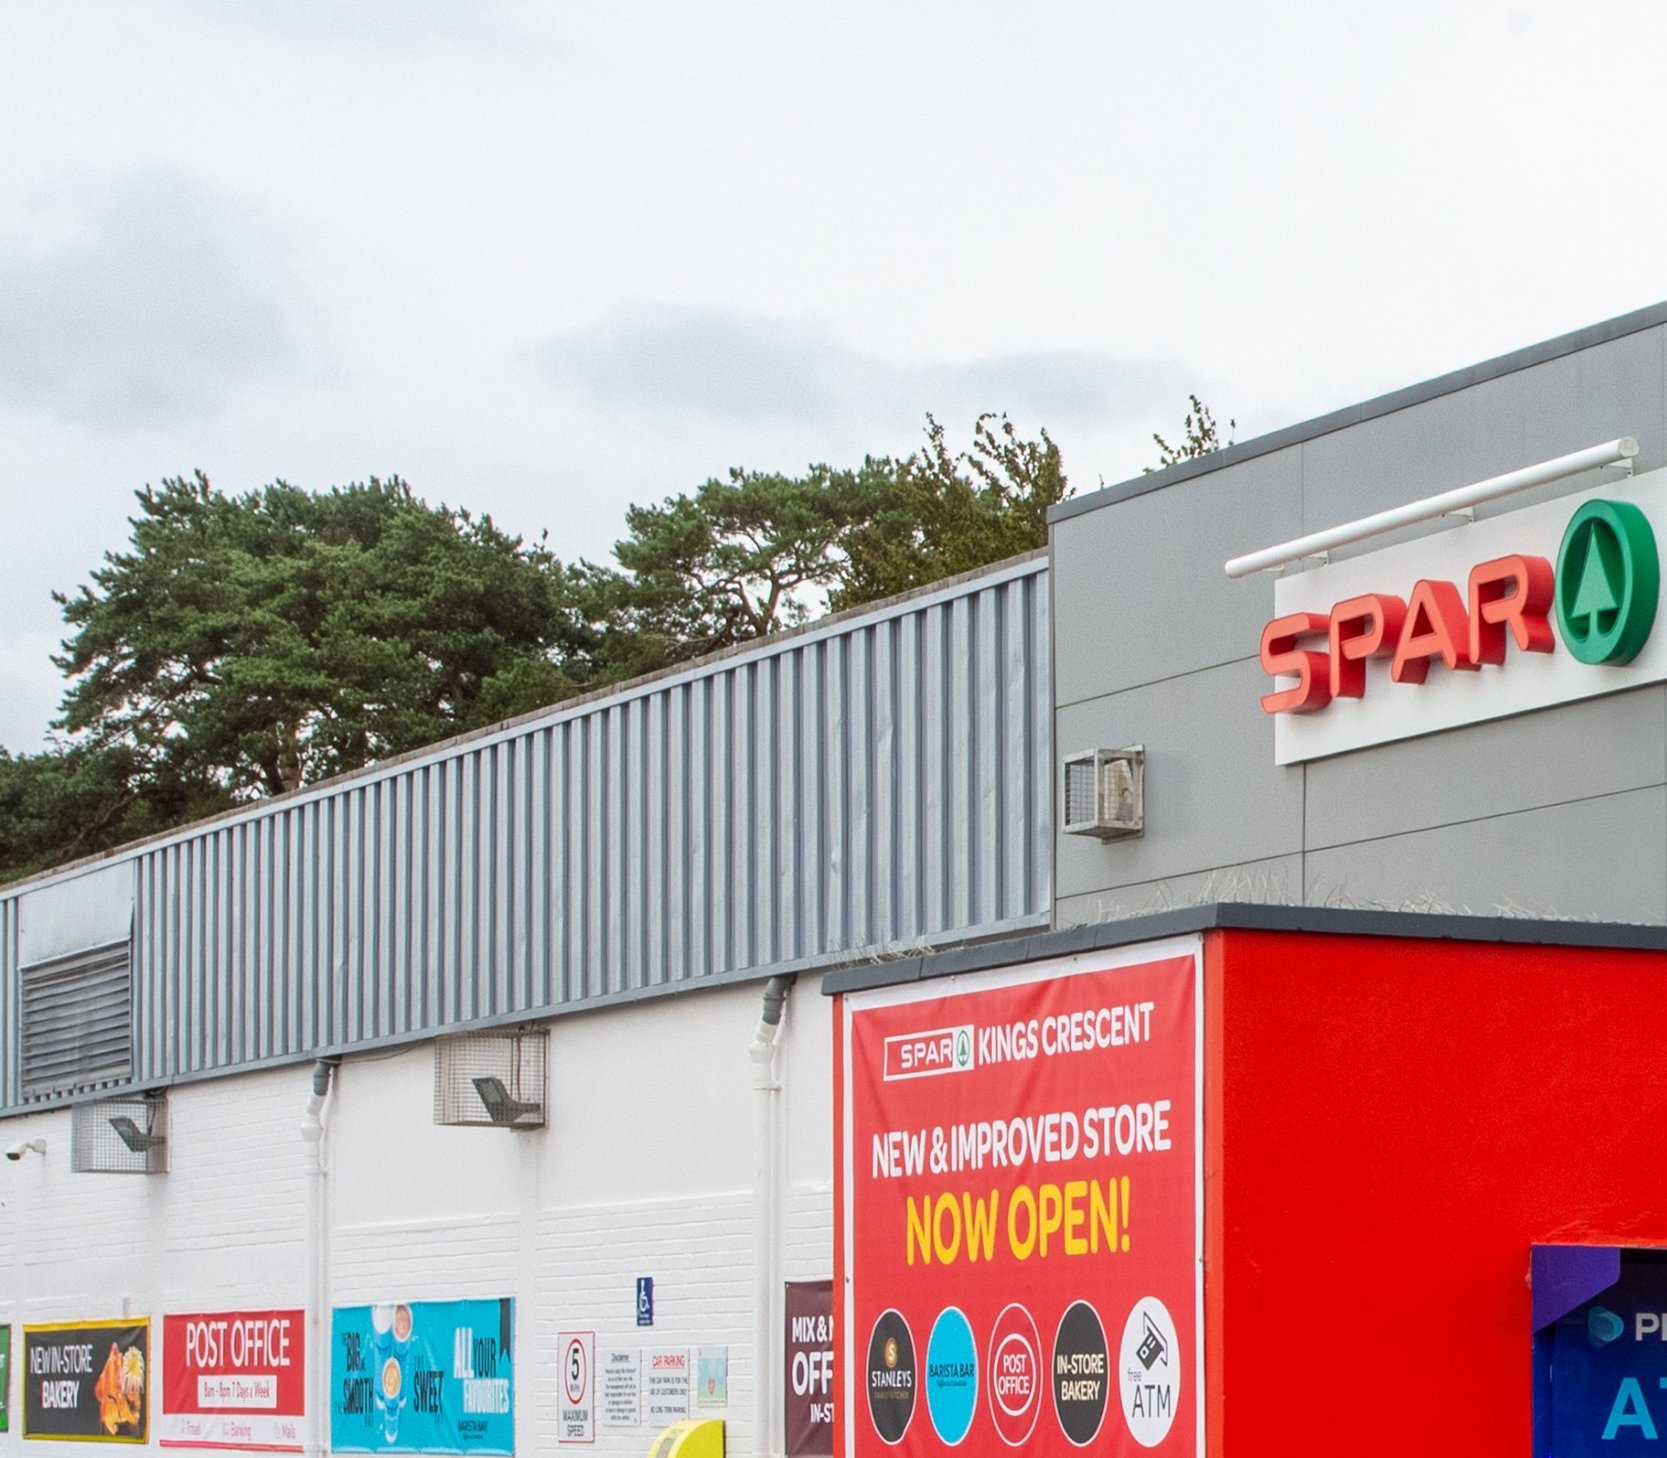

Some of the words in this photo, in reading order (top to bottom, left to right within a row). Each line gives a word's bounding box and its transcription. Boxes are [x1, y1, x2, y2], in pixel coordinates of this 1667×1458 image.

[1260, 553, 1555, 715] SPAR
[900, 1037, 953, 1070] SPAR
[978, 1021, 1040, 1066] KINGS
[1041, 1001, 1154, 1052] CRESCENT
[872, 1128, 926, 1179] NEW
[930, 1127, 948, 1174] &
[951, 1111, 1080, 1173] IMPROVED
[1083, 1100, 1172, 1158] STORE
[905, 1188, 1000, 1267] NOW
[1006, 1175, 1132, 1261] OPEN!
[186, 1321, 227, 1368] POST
[230, 1319, 290, 1367] OFFICE
[792, 1317, 815, 1343] MIX
[816, 1316, 828, 1342] &
[30, 1346, 50, 1374] NEW
[51, 1344, 93, 1374] IN-STORE
[453, 1327, 473, 1378] ALL
[474, 1337, 496, 1378] YOUR
[572, 1348, 580, 1380] 5
[652, 1354, 663, 1367] CAR
[1003, 1354, 1026, 1373] POST
[1057, 1354, 1105, 1375] IN-STORE
[791, 1351, 834, 1396] OFF
[871, 1370, 913, 1388] STANLEYS
[929, 1363, 959, 1377] BARISTA
[960, 1363, 974, 1377] BAR
[42, 1380, 79, 1409] BAKERY
[344, 1377, 373, 1414] SMOOTH
[999, 1376, 1030, 1395] OFFICE
[1061, 1380, 1101, 1401] BAKERY
[563, 1409, 588, 1422] MAXIMUM
[1132, 1384, 1171, 1418] ATM
